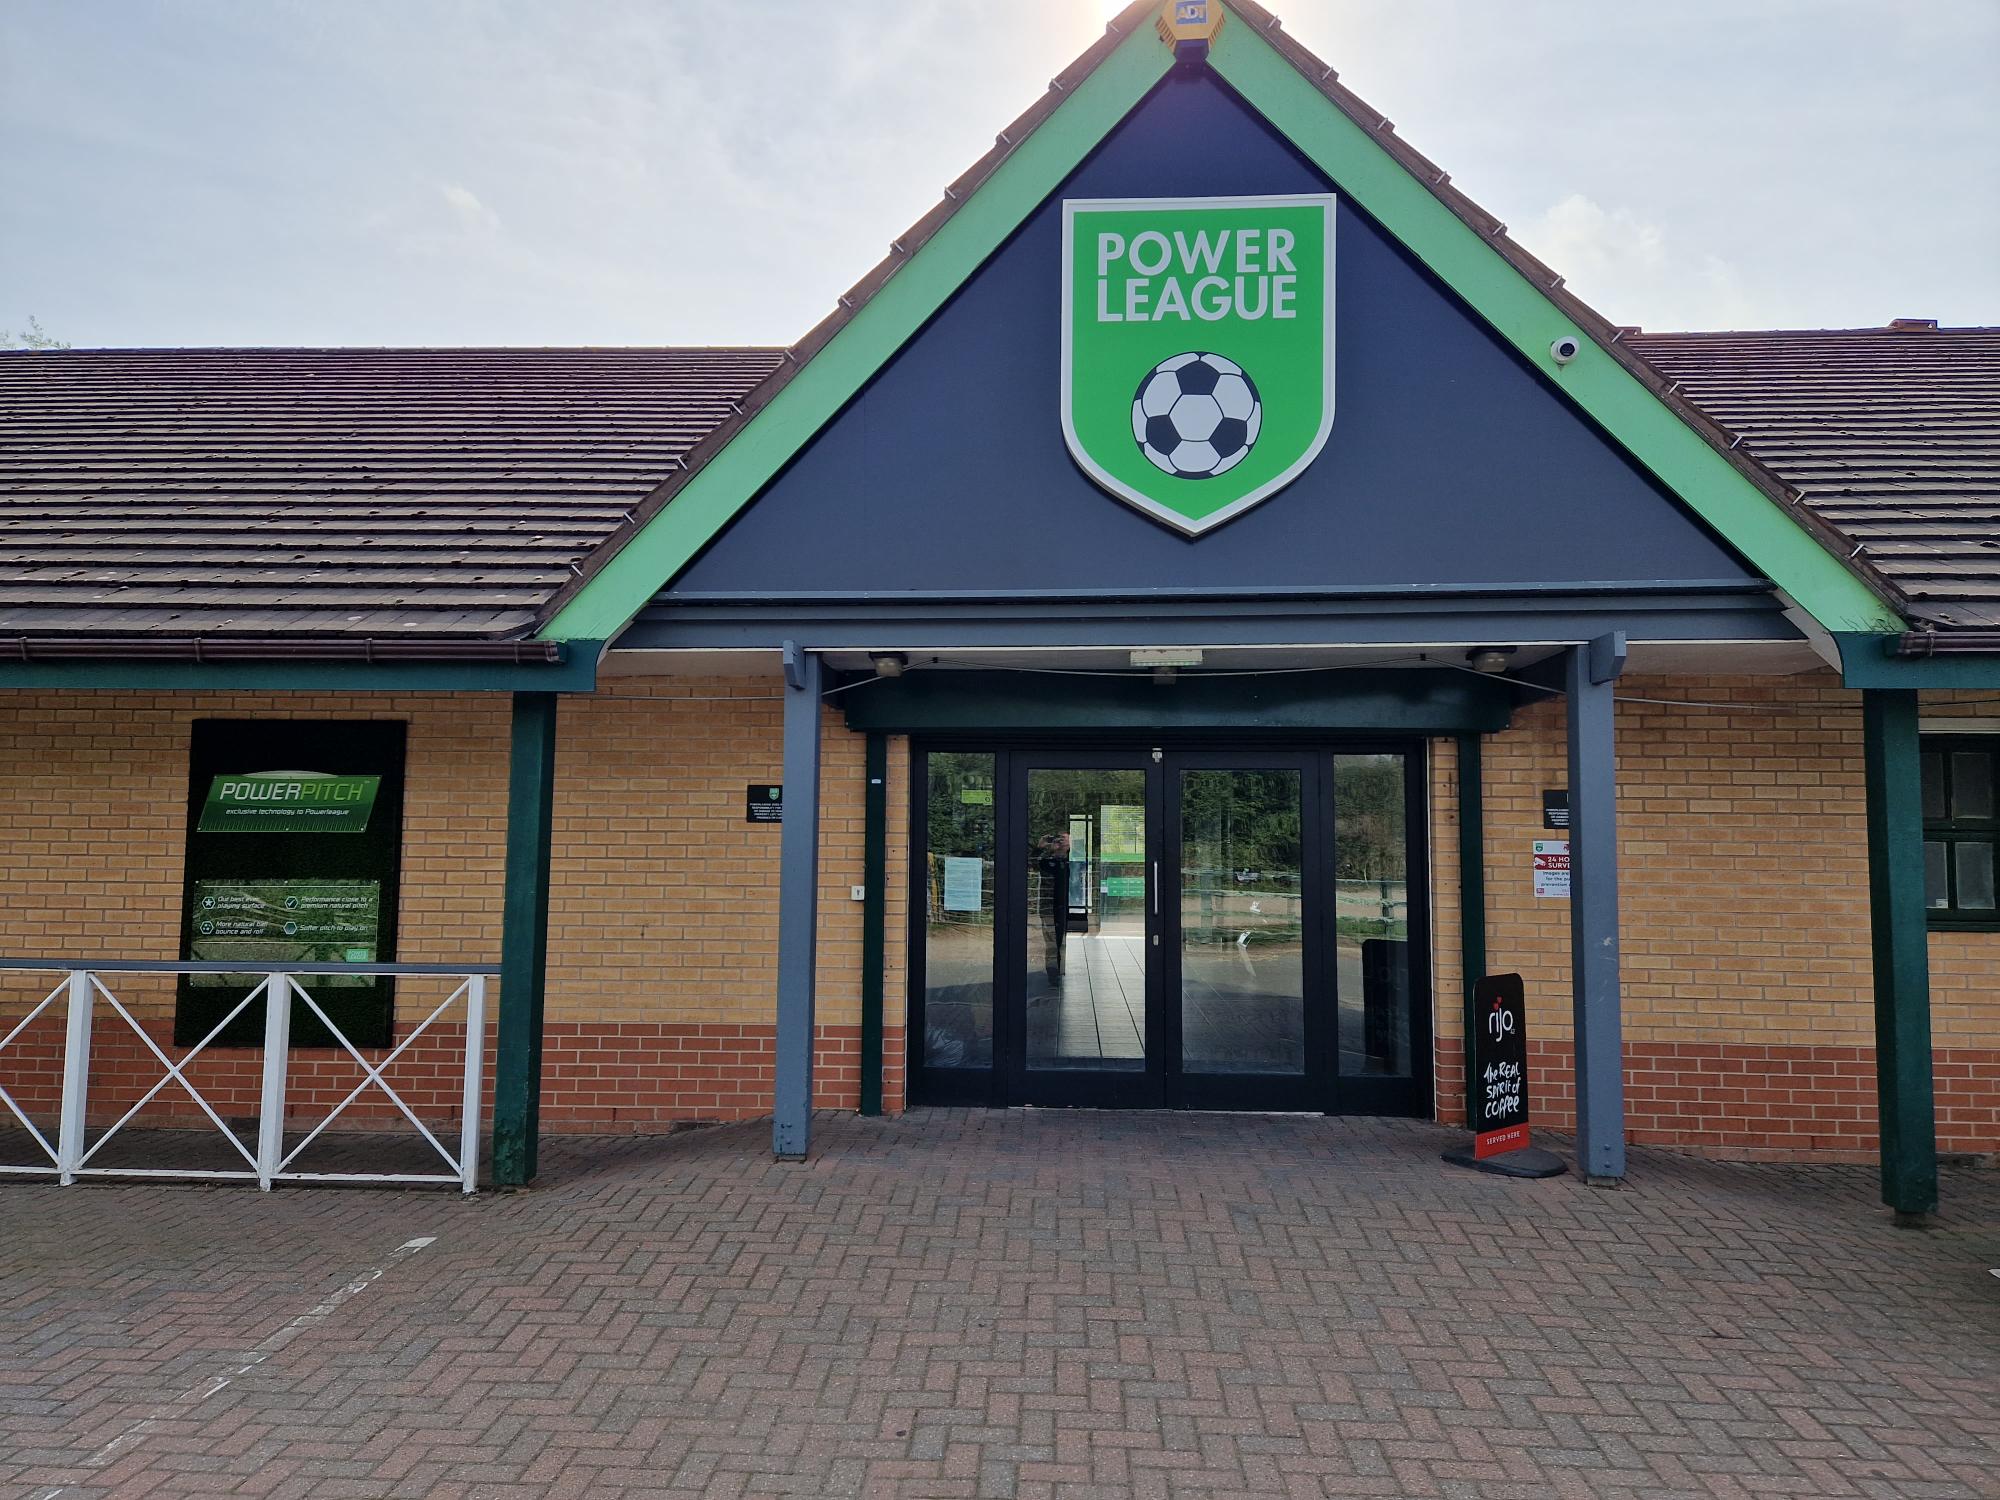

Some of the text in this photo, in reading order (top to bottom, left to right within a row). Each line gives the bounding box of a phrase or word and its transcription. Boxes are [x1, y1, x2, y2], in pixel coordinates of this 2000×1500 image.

[1098, 228, 1297, 276] POWER
[1098, 275, 1297, 322] LEAGUE
[219, 782, 363, 801] POWERPITCH
[258, 808, 295, 816] technology
[305, 808, 350, 816] Powerleague
[1489, 1007, 1514, 1042] rijo
[1512, 1076, 1521, 1095] of
[1486, 1130, 1521, 1145] SERVED HERE
